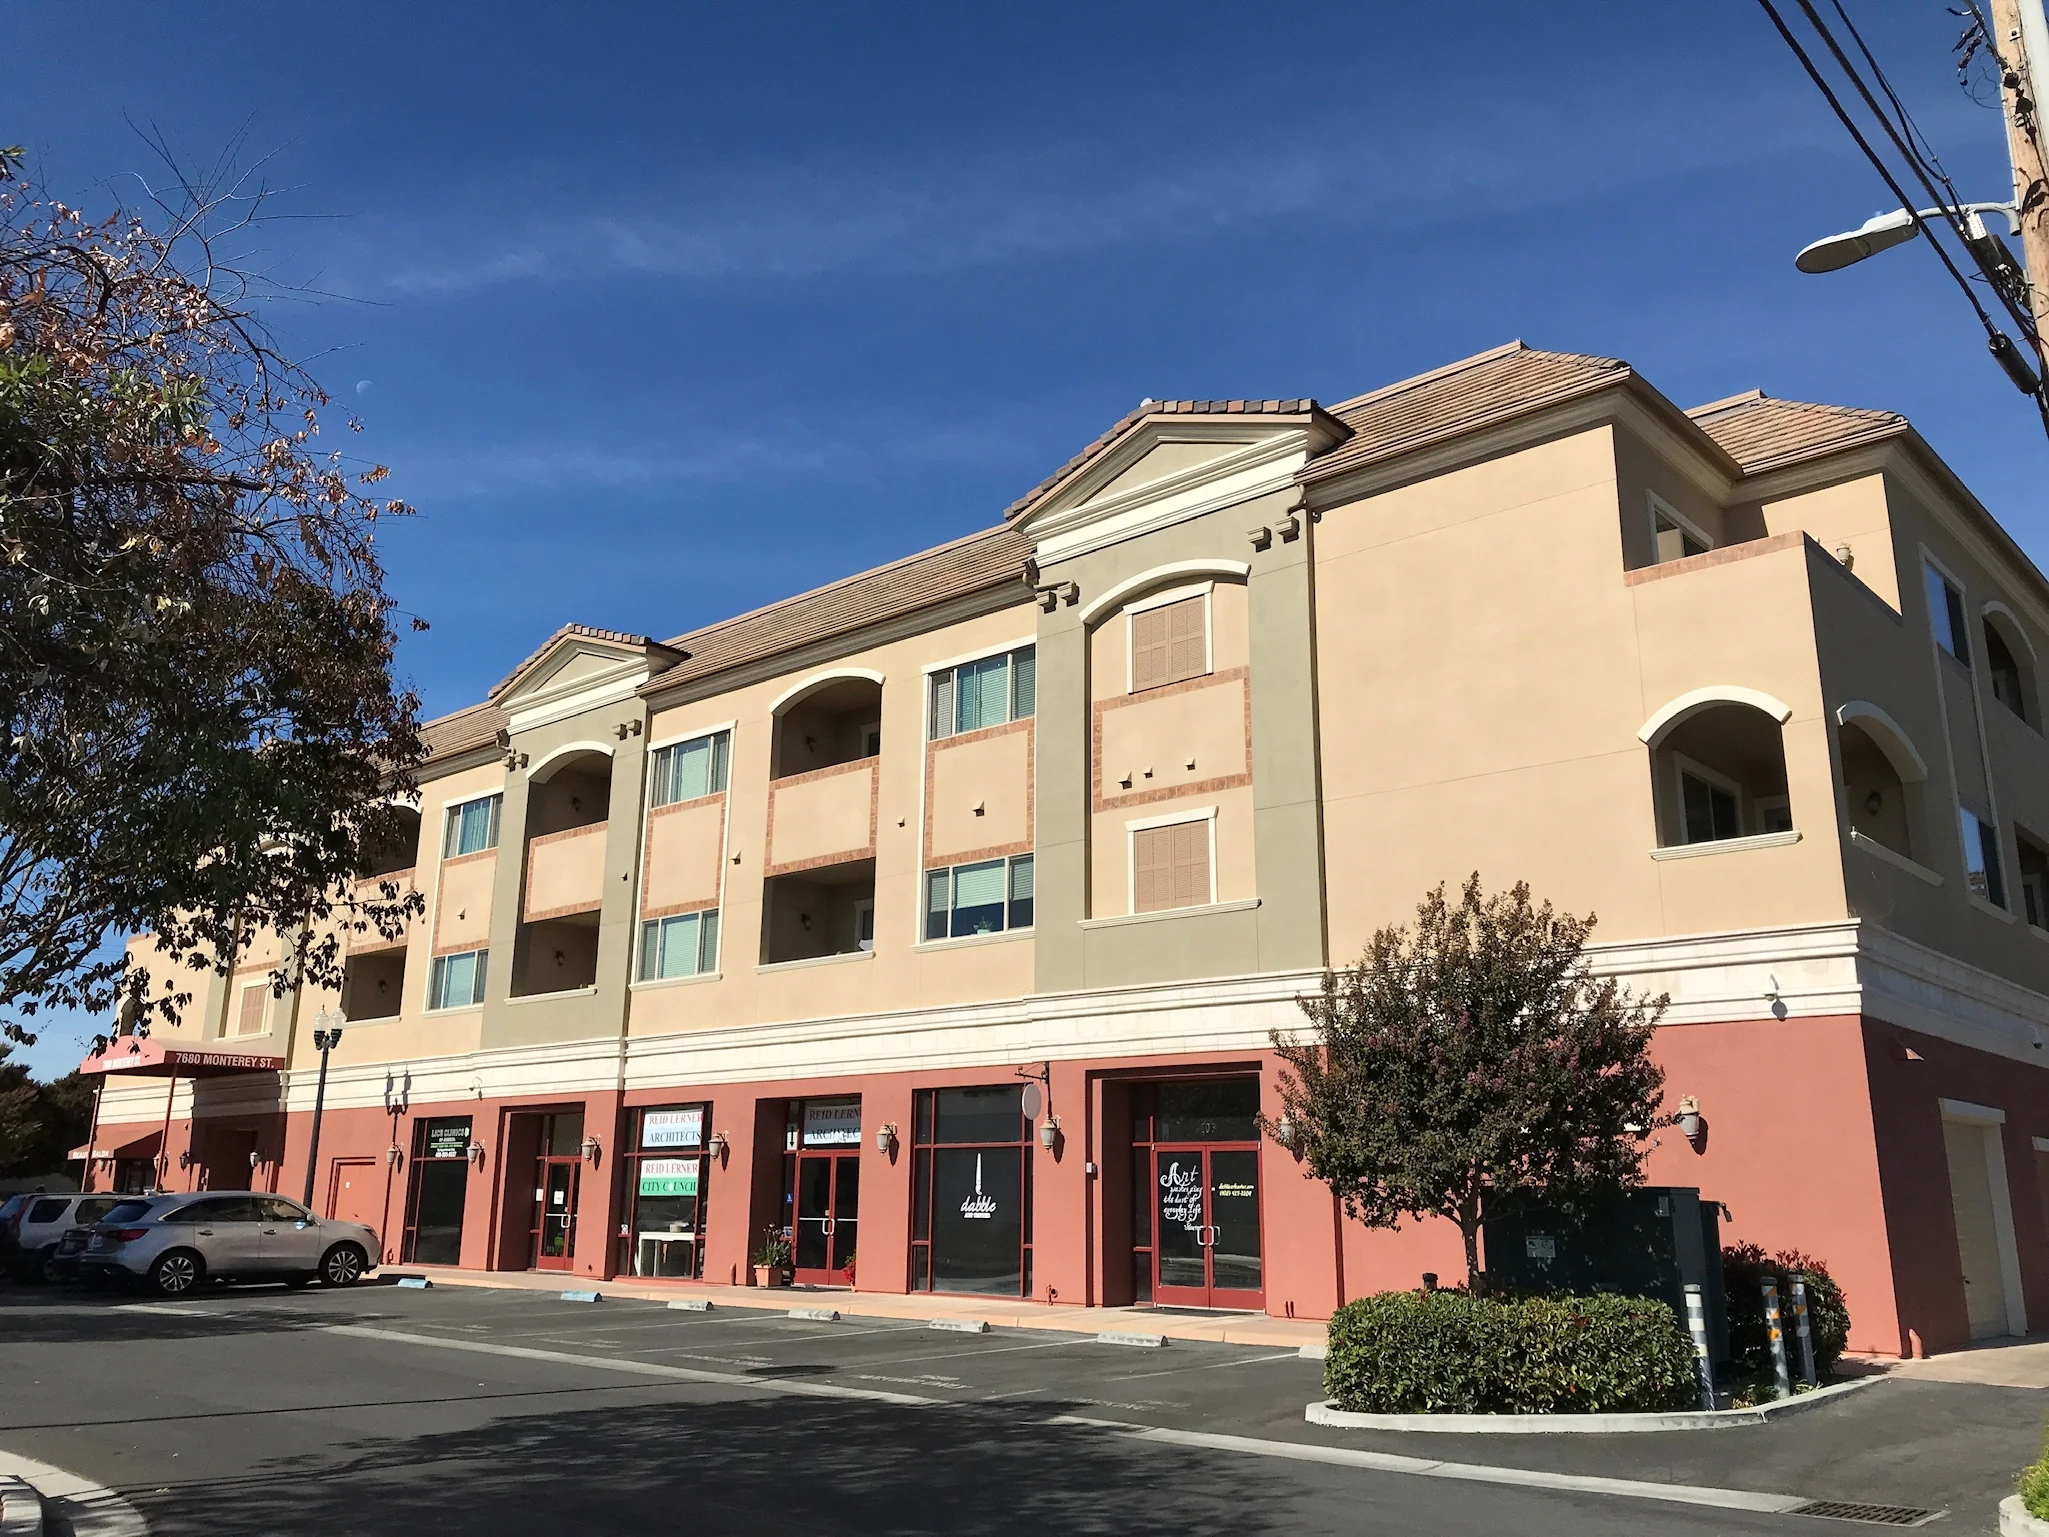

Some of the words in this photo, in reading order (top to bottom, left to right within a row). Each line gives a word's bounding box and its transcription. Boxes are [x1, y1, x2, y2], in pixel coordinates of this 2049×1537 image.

[175, 1053, 200, 1064] 7680
[203, 1054, 257, 1067] MONTEREY
[259, 1058, 275, 1068] ST.
[649, 1115, 668, 1124] REID
[670, 1112, 703, 1124] LERNER
[809, 1109, 831, 1120] REID
[834, 1108, 861, 1119] LERN
[649, 1131, 702, 1143] ARCHITECTS
[810, 1127, 861, 1140] ARCHITEC
[645, 1163, 664, 1174] REID
[666, 1163, 698, 1174] LERNER
[1160, 1162, 1199, 1187] Art
[642, 1181, 660, 1192] CITY
[662, 1181, 697, 1192] CUNCIL
[960, 1195, 997, 1212] dabble
